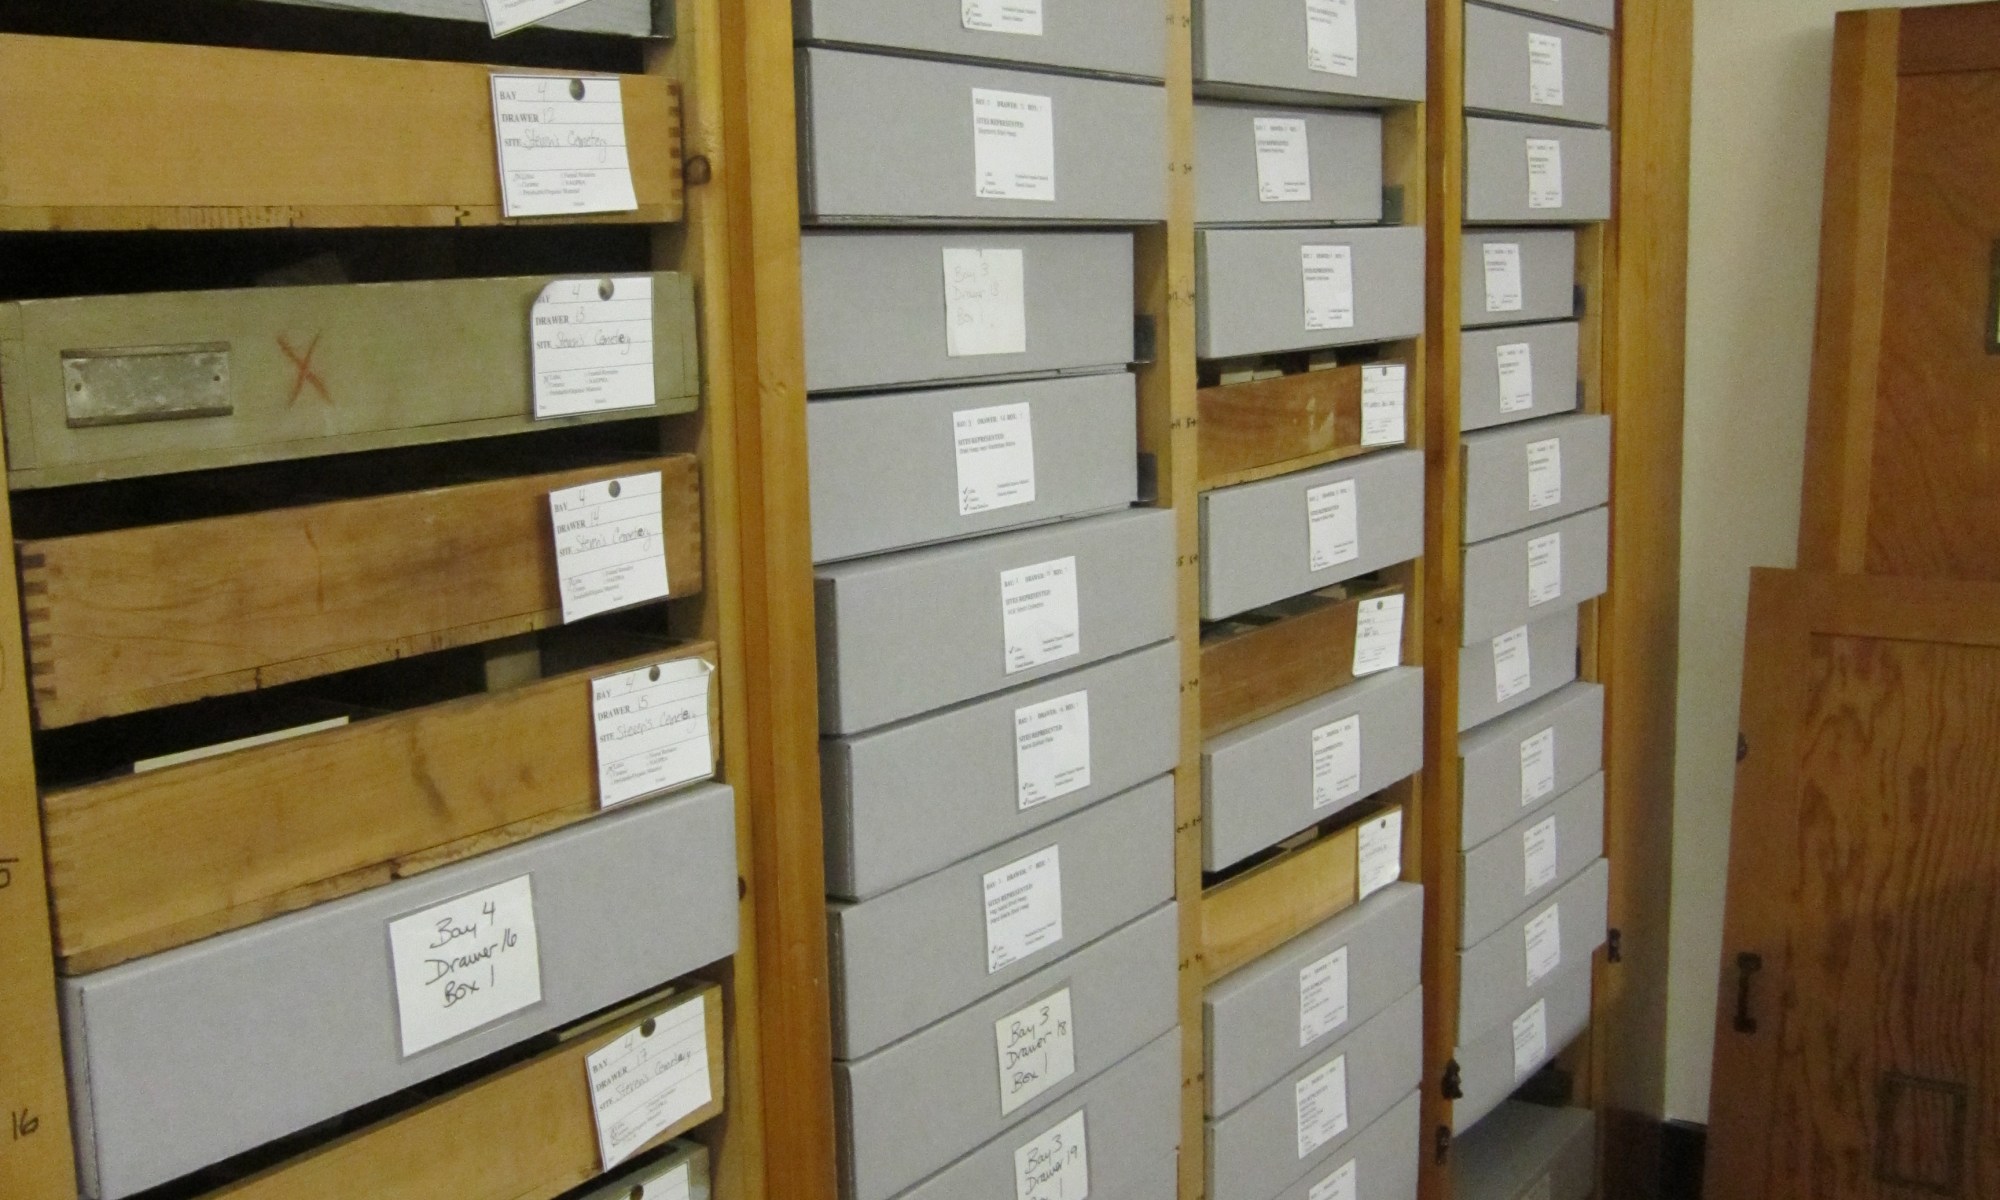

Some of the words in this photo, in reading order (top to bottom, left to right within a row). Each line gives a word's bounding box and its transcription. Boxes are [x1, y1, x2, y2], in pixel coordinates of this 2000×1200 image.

[500, 91, 516, 100] BAY
[538, 82, 547, 102] 4
[501, 113, 539, 122] DRAWER
[504, 138, 521, 147] SITE
[535, 315, 569, 326] DRAWER
[536, 340, 552, 349] SITE
[554, 502, 567, 512] BAY
[578, 489, 585, 506] 4
[557, 519, 586, 534] DRAWER
[559, 547, 571, 557] SITE
[596, 690, 611, 700] BAY
[626, 673, 636, 692] 4
[598, 705, 630, 721] DRAWER
[638, 695, 649, 711] 15
[599, 732, 615, 743] SITE
[429, 917, 477, 949] Bay
[482, 901, 496, 926] 4
[424, 943, 498, 986] Drawer
[502, 928, 518, 952] 16
[443, 980, 480, 1008] Box
[1007, 1021, 1035, 1048] Bay
[1040, 1006, 1049, 1025] 3
[1006, 1032, 1052, 1070] Drawer
[1057, 1019, 1066, 1037] 18
[592, 1058, 607, 1073] BAY
[596, 1066, 627, 1092] DRAWER
[1011, 1072, 1038, 1094] Box
[599, 1097, 613, 1110] SITE
[12, 1108, 39, 1141] 16
[1025, 1147, 1051, 1174] Bay
[1052, 1134, 1062, 1153] 3
[1025, 1159, 1063, 1195] Drawer
[1067, 1145, 1078, 1165] 19
